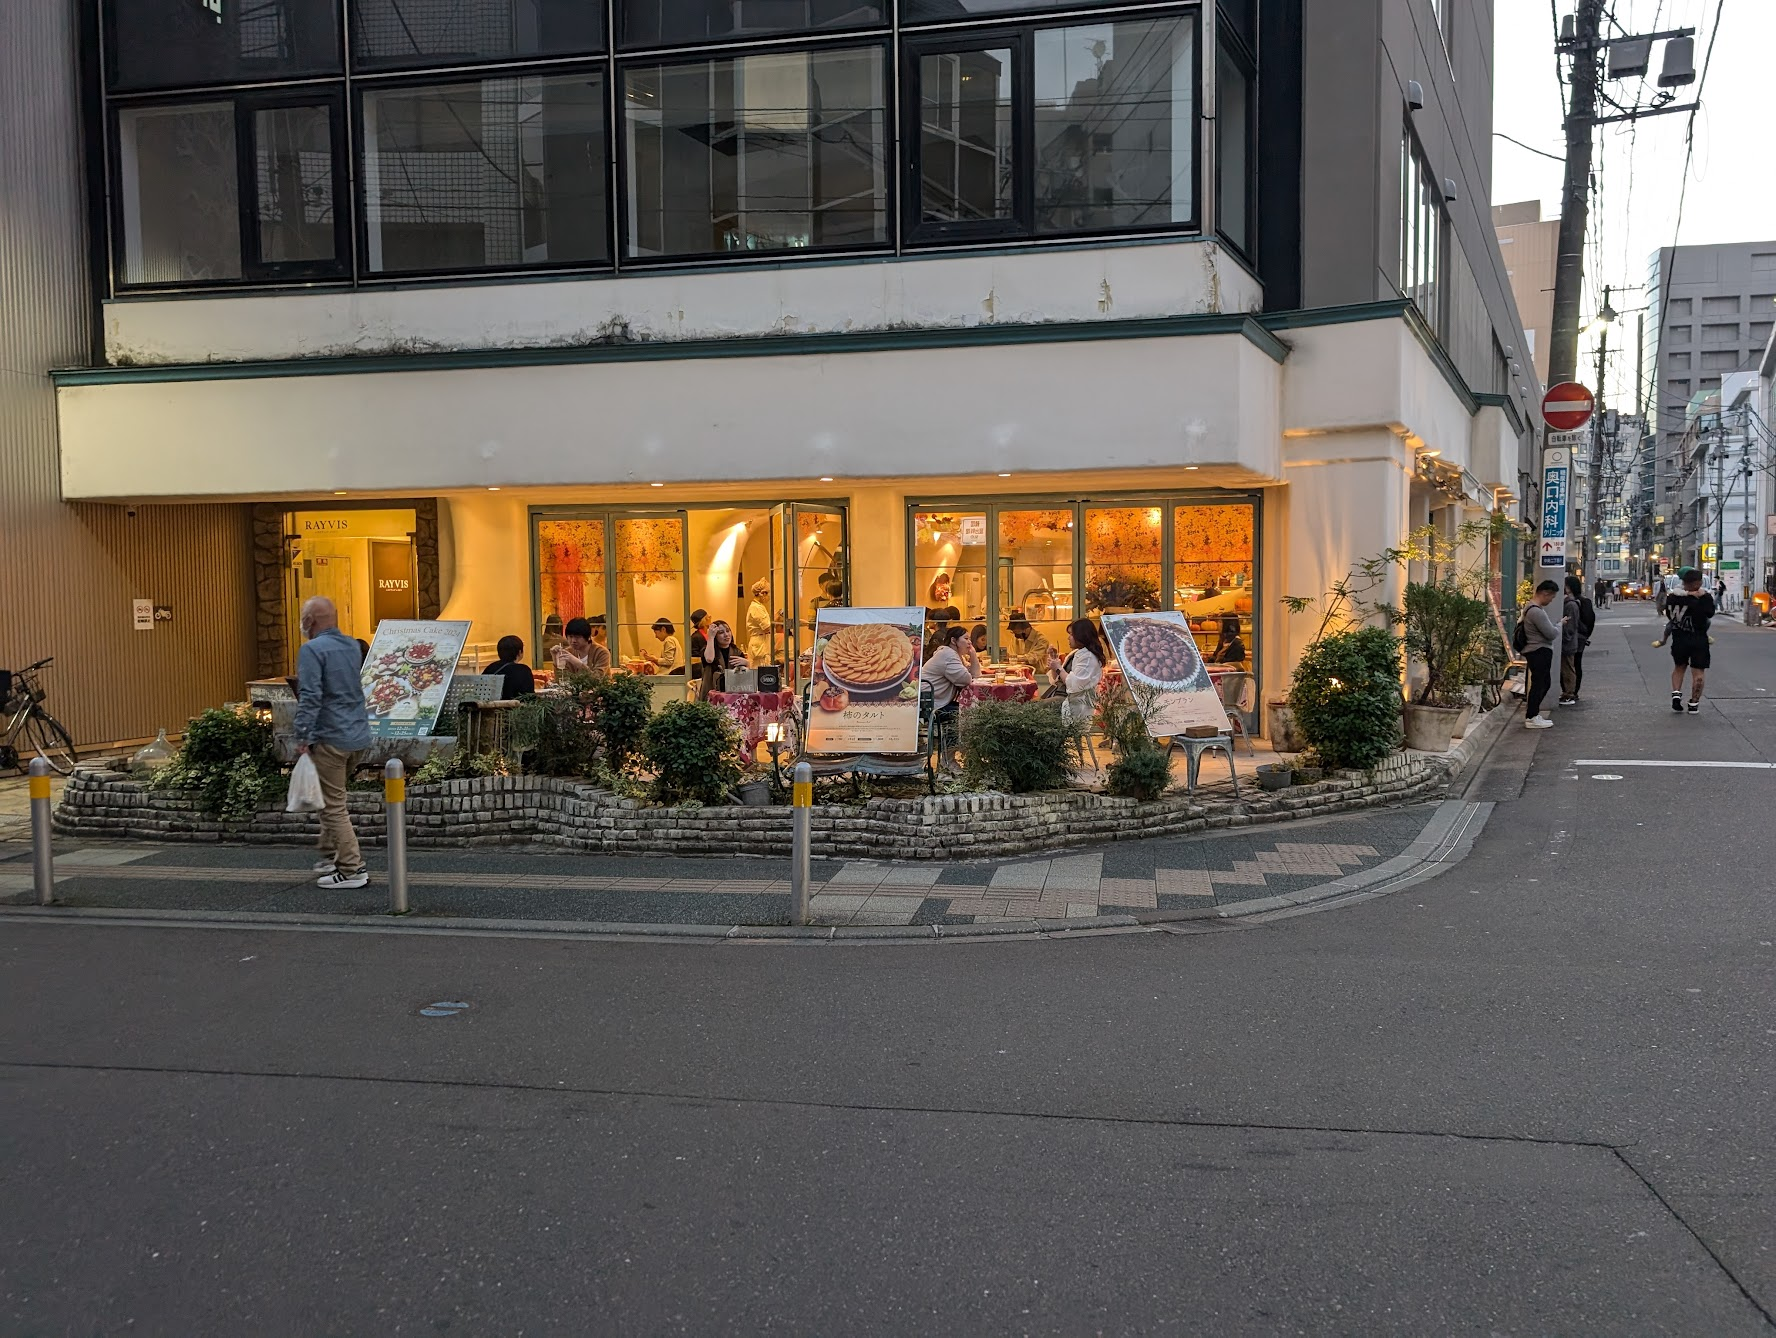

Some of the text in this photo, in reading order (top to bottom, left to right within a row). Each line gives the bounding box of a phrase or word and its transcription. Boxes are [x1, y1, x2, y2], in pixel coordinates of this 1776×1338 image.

[1544, 471, 1560, 529] 奥口内科
[305, 519, 348, 530] RAYVIS
[1543, 529, 1564, 537] クリニック
[379, 579, 409, 588] RAYVIS
[382, 626, 461, 637] Christmas Cake 2024
[842, 710, 885, 720] 柿のタルト
